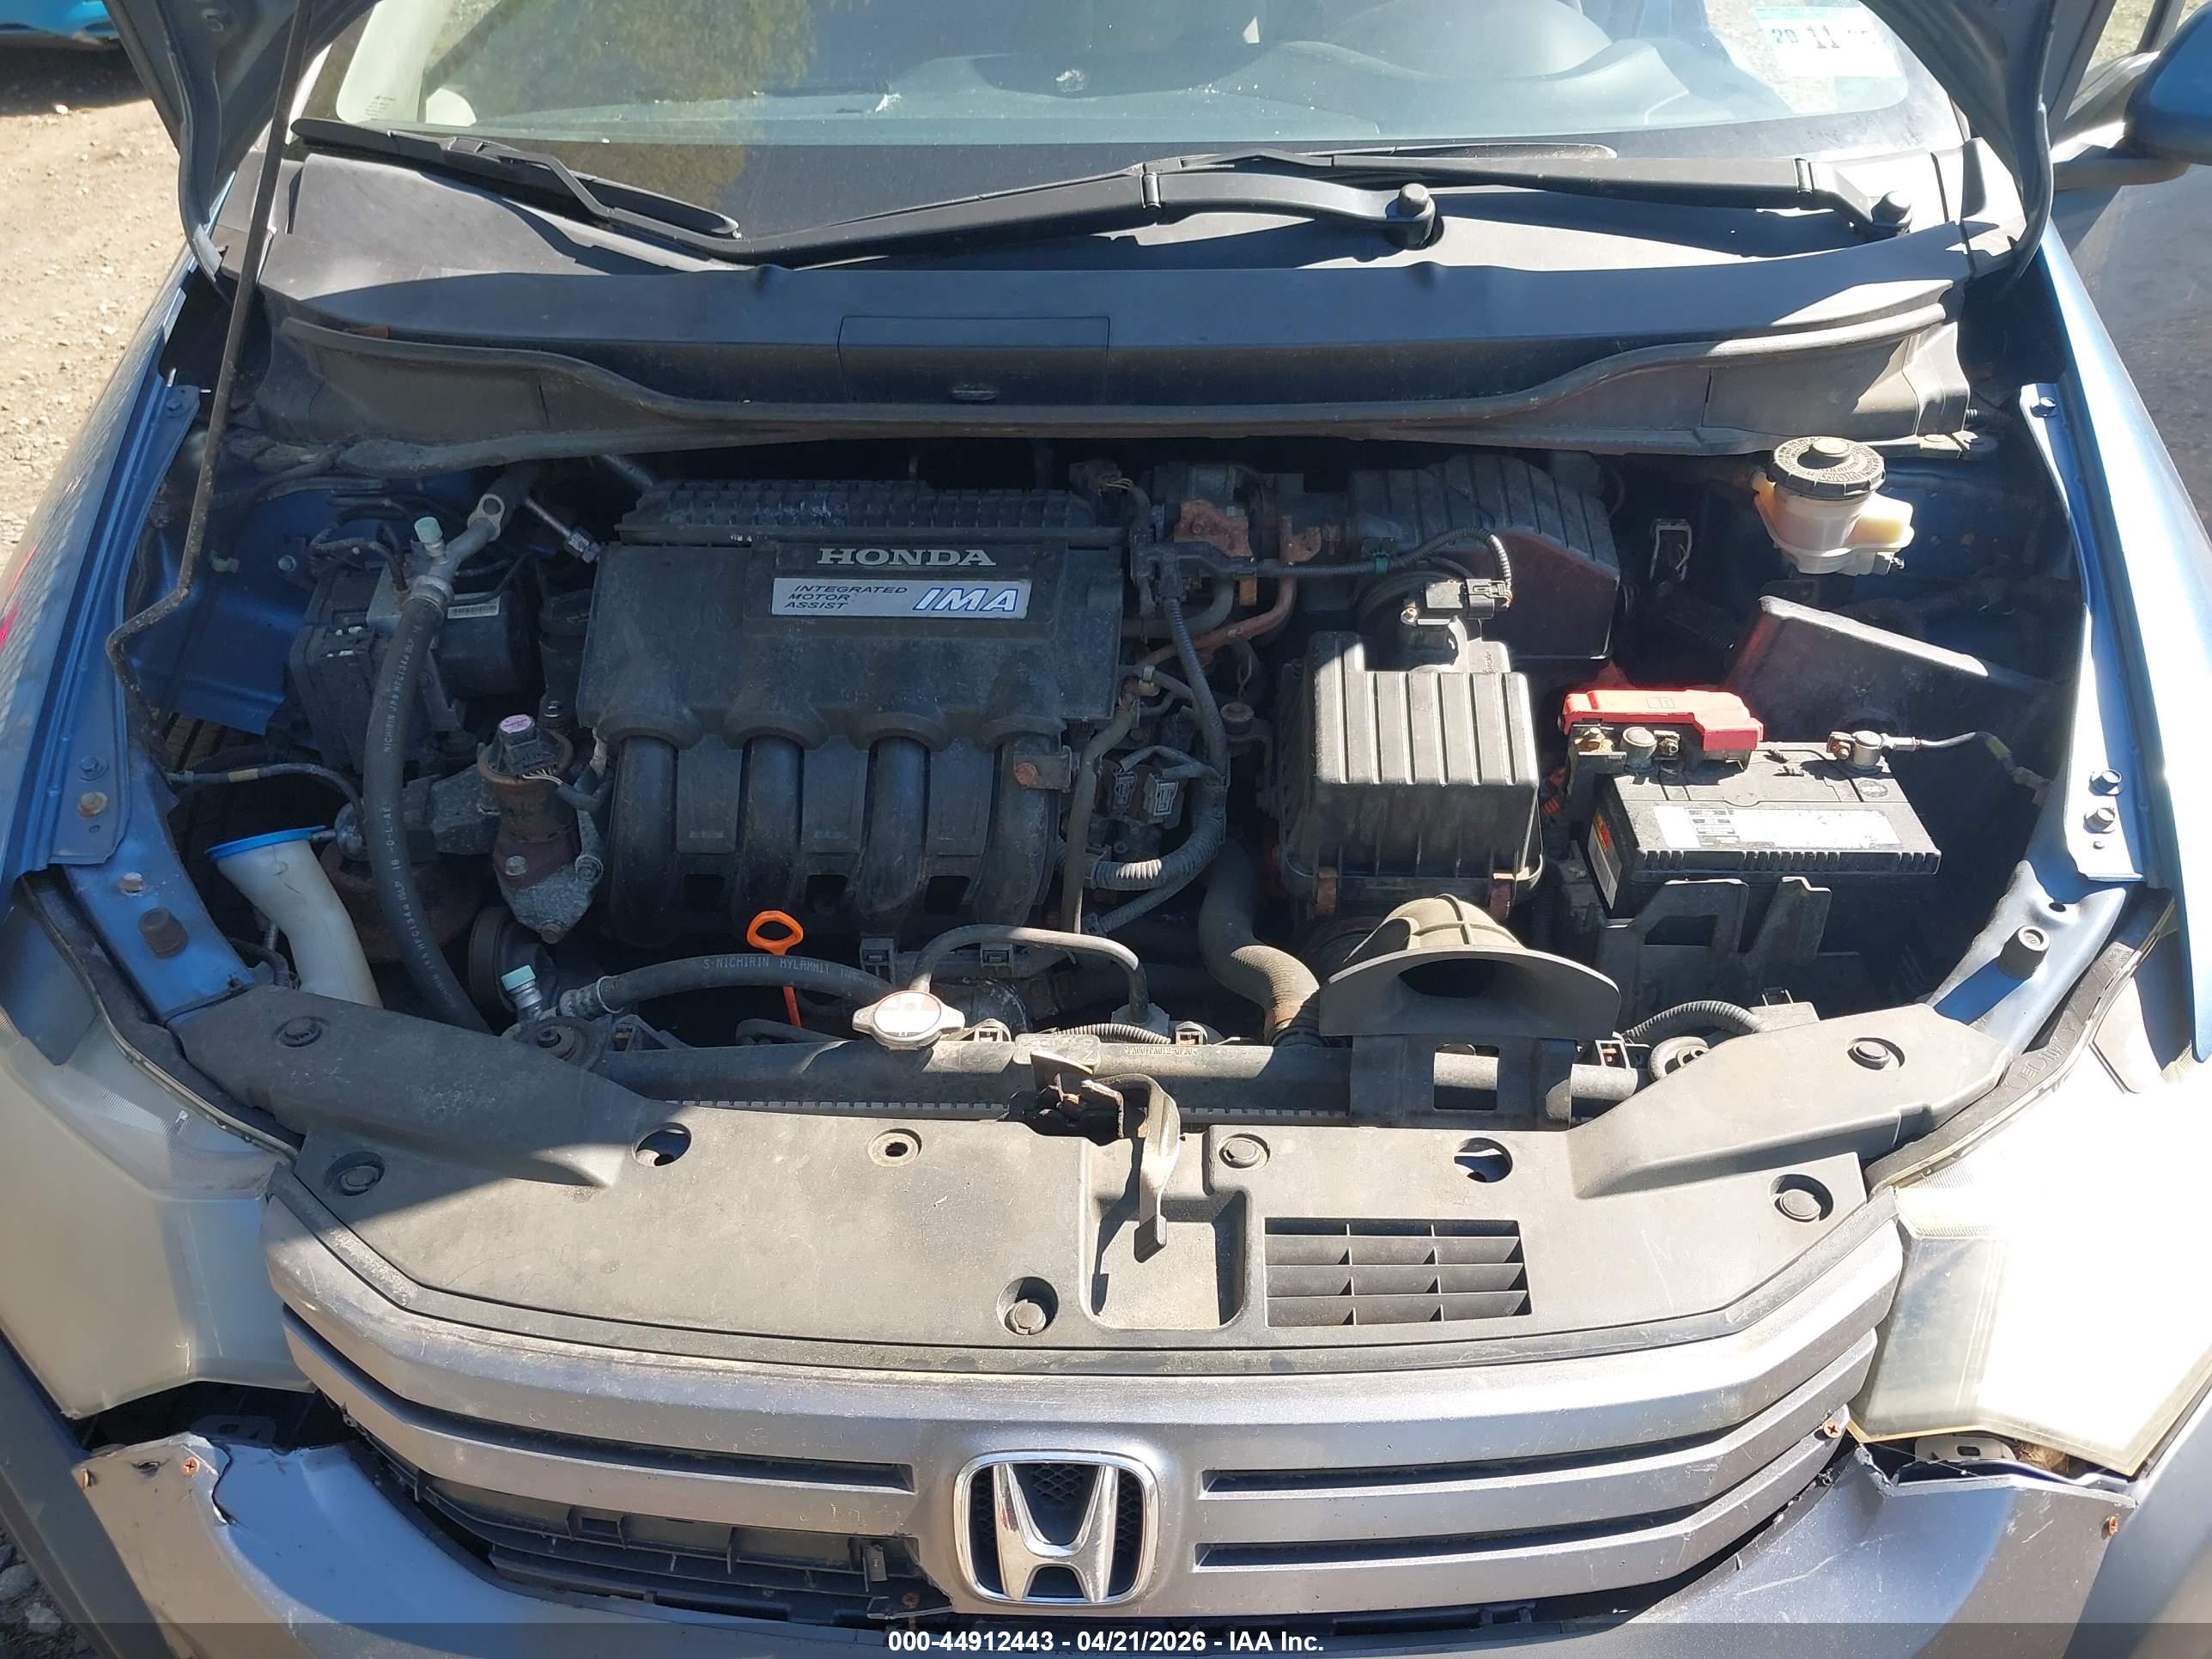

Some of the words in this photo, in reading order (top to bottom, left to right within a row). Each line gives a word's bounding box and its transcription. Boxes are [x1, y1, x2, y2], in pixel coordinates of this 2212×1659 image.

[817, 548, 996, 567] HONDA
[794, 585, 908, 594] INTEGRATED
[788, 593, 851, 602] MOTOR
[913, 587, 1019, 612] IMA
[784, 601, 849, 611] ASSIST
